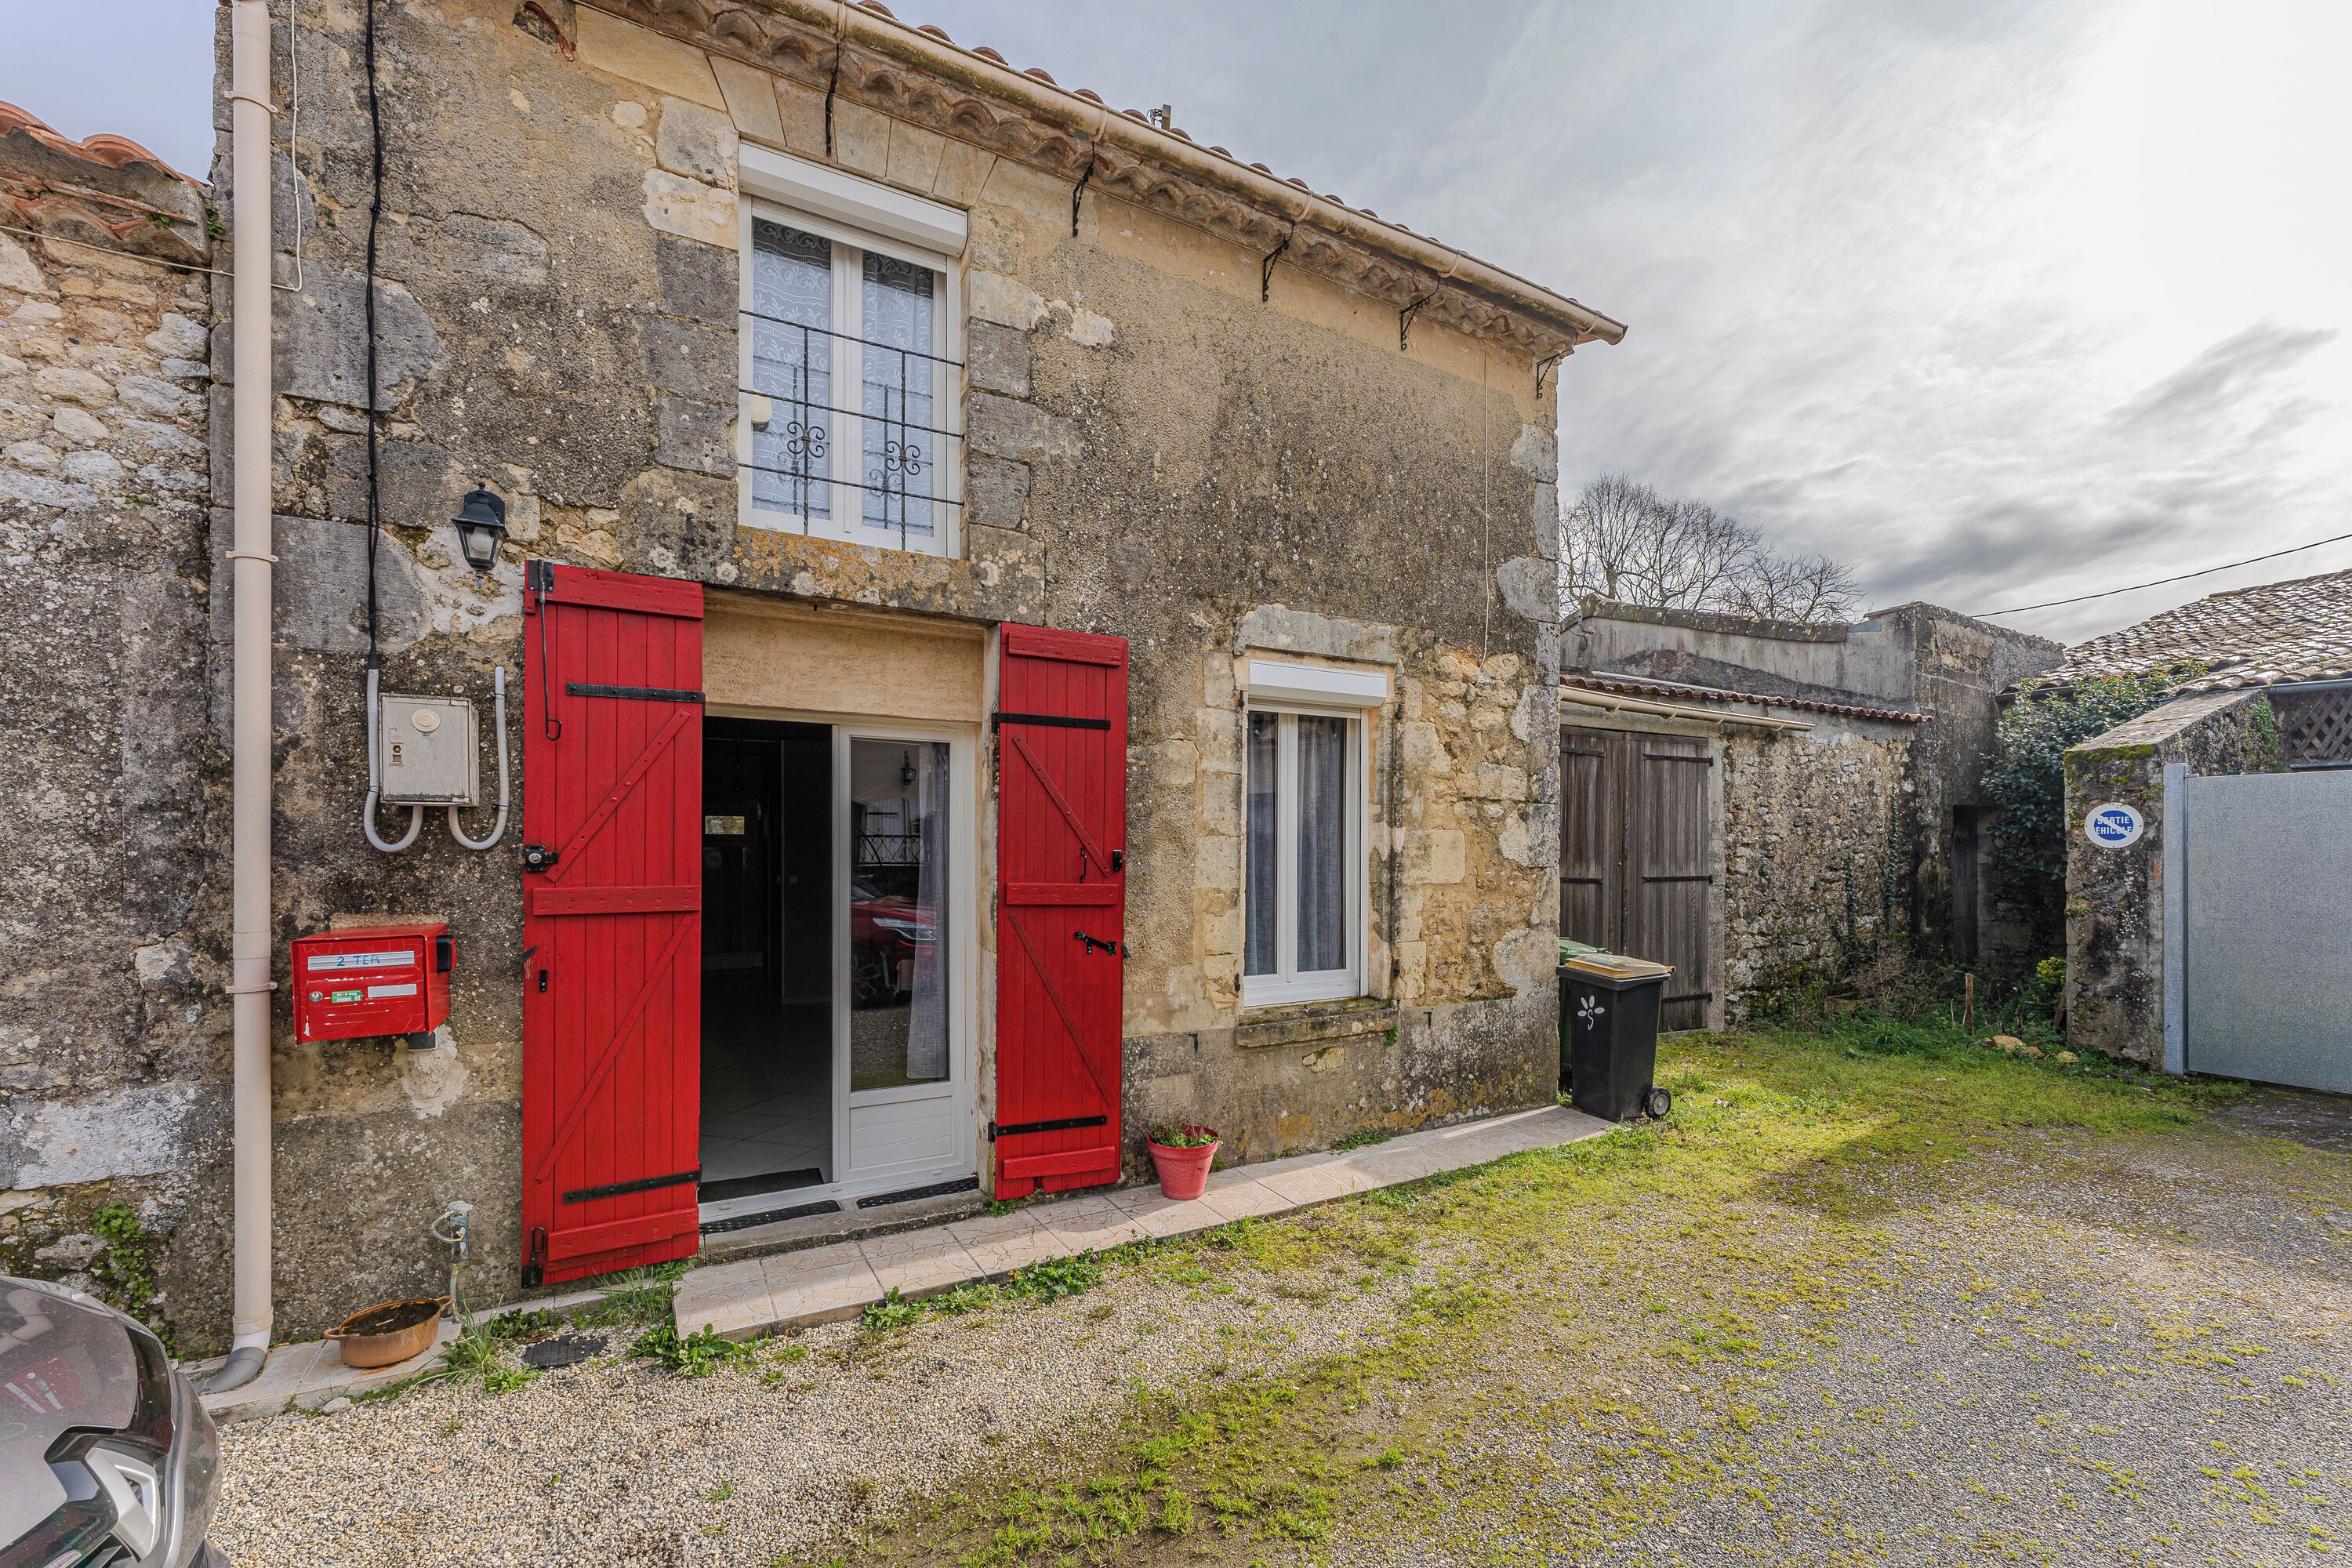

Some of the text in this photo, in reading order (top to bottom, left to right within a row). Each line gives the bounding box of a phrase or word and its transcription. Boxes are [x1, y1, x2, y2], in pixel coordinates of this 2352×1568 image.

[2096, 816, 2130, 825] SRTIE
[336, 955, 380, 967] 2 TER
